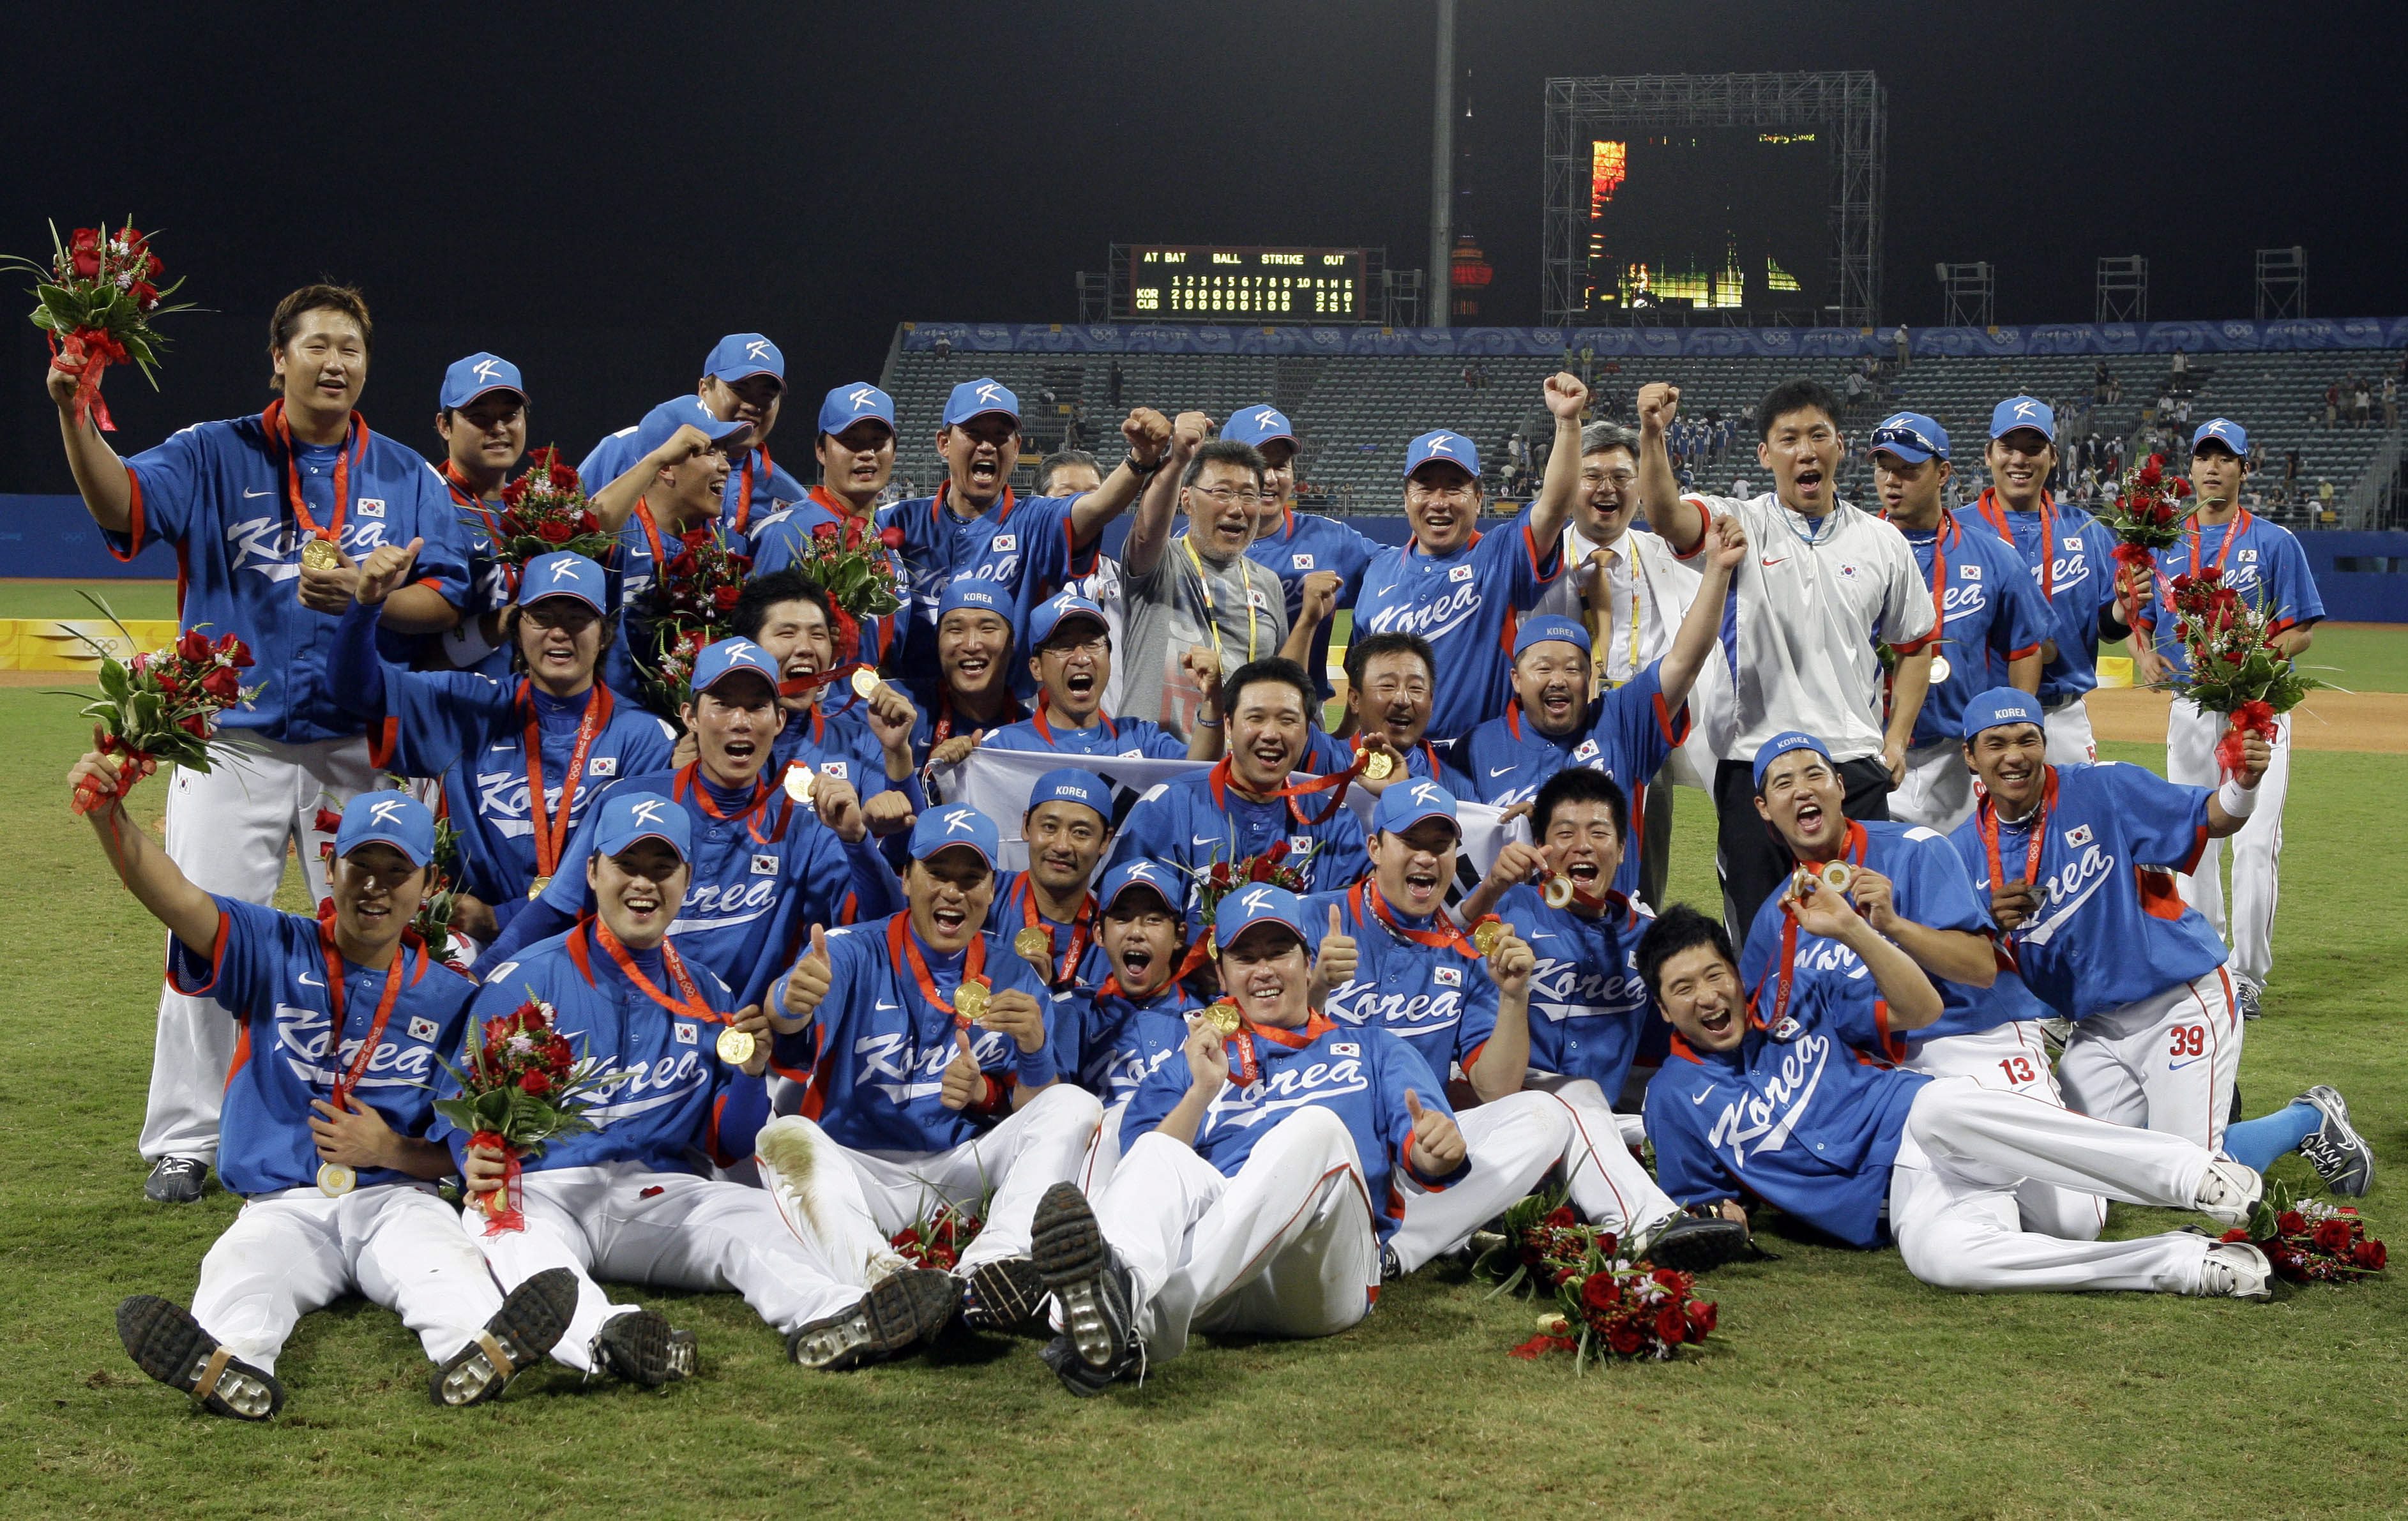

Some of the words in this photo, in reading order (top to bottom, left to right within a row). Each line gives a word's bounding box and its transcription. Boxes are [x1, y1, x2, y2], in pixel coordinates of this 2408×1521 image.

[1144, 252, 1159, 262] AT
[1164, 252, 1186, 262] BAT
[1213, 254, 1242, 264] BALL
[1261, 254, 1304, 264] STRIKE
[1323, 255, 1345, 265] OUT
[1172, 276, 1181, 285] 1
[1186, 276, 1194, 286] 2
[1200, 276, 1208, 286] 3
[1213, 276, 1222, 286] 4
[1228, 276, 1235, 286] 5
[1241, 277, 1249, 287] 6
[1255, 277, 1262, 287] 7
[1269, 278, 1277, 287] 8
[1282, 278, 1291, 287] 9
[1296, 278, 1311, 288] 10
[1316, 279, 1325, 288] R
[1330, 280, 1338, 288] H
[1344, 280, 1352, 289] E
[1136, 289, 1159, 299] KOR
[1170, 289, 1180, 299] 2
[1185, 289, 1194, 299] 0
[1198, 289, 1208, 299] 0
[1212, 290, 1222, 299] 0
[1226, 290, 1236, 300] 0
[1239, 291, 1249, 300] 0
[1255, 291, 1262, 300] 1
[1267, 291, 1277, 301] 0
[1281, 291, 1291, 301] 0
[1315, 292, 1325, 301] 3
[1329, 292, 1338, 301] 4
[1343, 292, 1352, 301] 0
[1136, 299, 1159, 309] CUB
[1172, 299, 1179, 309] 1
[1185, 300, 1194, 310] 0
[1198, 300, 1208, 310] 0
[1212, 300, 1222, 310] 0
[1225, 301, 1235, 310] 0
[1239, 301, 1249, 310] 0
[1255, 301, 1262, 310] 1
[1267, 301, 1277, 311] 0
[1281, 301, 1291, 311] 0
[1315, 302, 1325, 312] 2
[1329, 302, 1338, 312] 5
[1344, 302, 1352, 312] 1
[963, 592, 993, 605] KOREA
[1546, 627, 1575, 641] KOREA
[1994, 708, 2027, 720] KOREA
[1777, 735, 1810, 749] KOREA
[1056, 786, 1087, 800] KOREA
[1527, 958, 1647, 1015] Korea
[1324, 978, 1462, 1031] Korea
[2171, 1026, 2204, 1056] 39
[1999, 1057, 2036, 1085] 13
[1708, 1033, 1830, 1167] Korea
